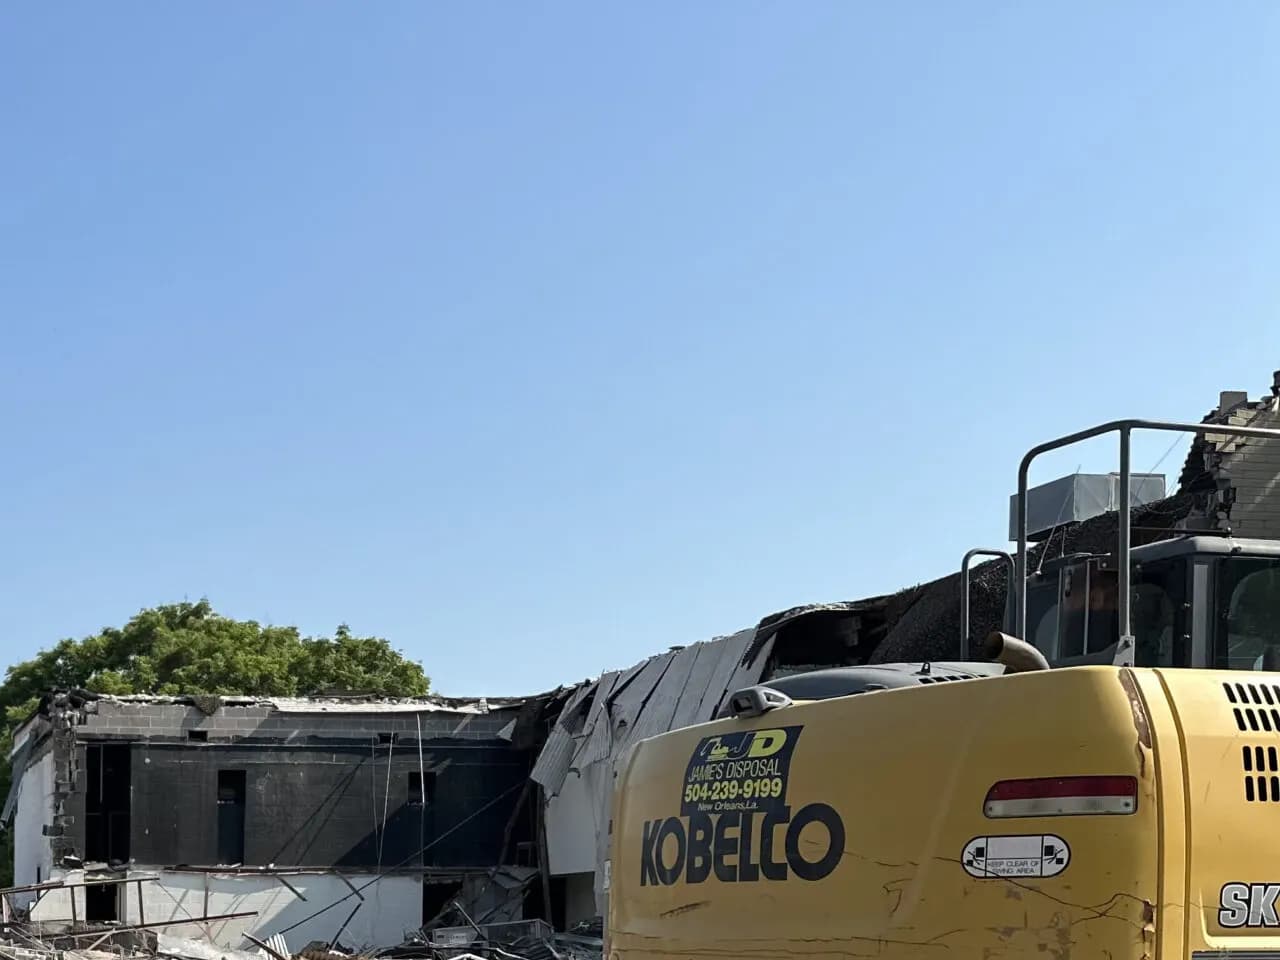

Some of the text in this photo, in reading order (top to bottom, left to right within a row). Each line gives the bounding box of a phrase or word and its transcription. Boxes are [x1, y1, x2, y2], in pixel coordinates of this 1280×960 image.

[726, 758, 782, 779] DISPOSAL
[684, 778, 782, 803] 504-239-9199
[697, 803, 713, 812] New
[640, 802, 845, 887] KOBELCO
